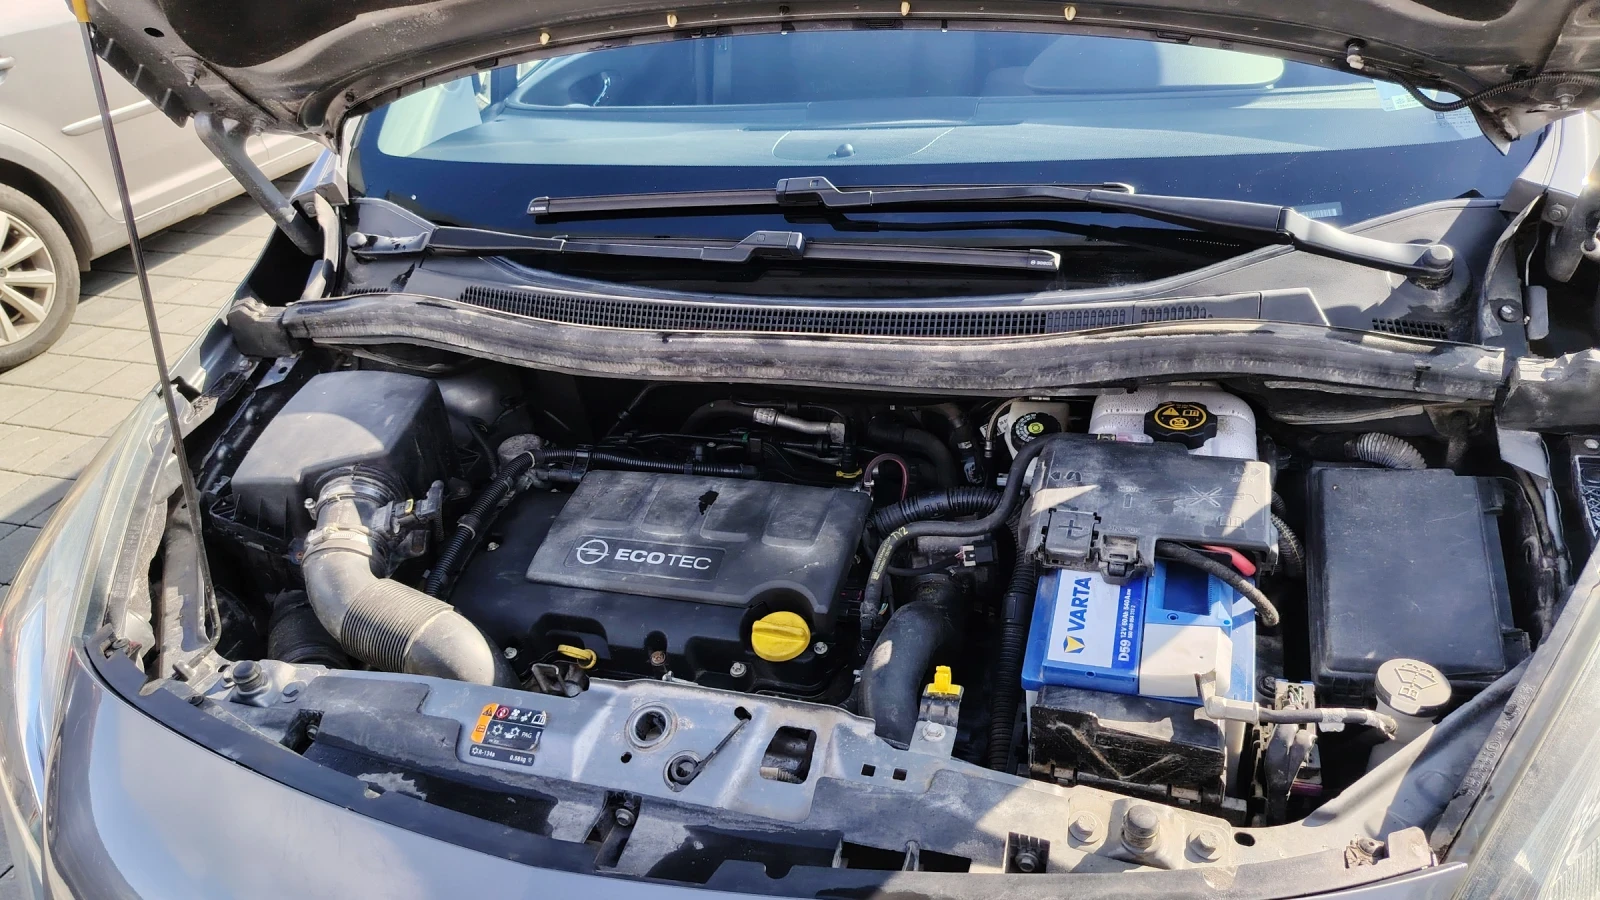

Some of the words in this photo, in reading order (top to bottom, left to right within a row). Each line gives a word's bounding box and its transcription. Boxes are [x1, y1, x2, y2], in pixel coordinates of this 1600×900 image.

[614, 548, 712, 570] ECOTEC
[1067, 577, 1091, 632] VARTA
[1118, 640, 1131, 661] D59
[478, 749, 496, 757] R-134a
